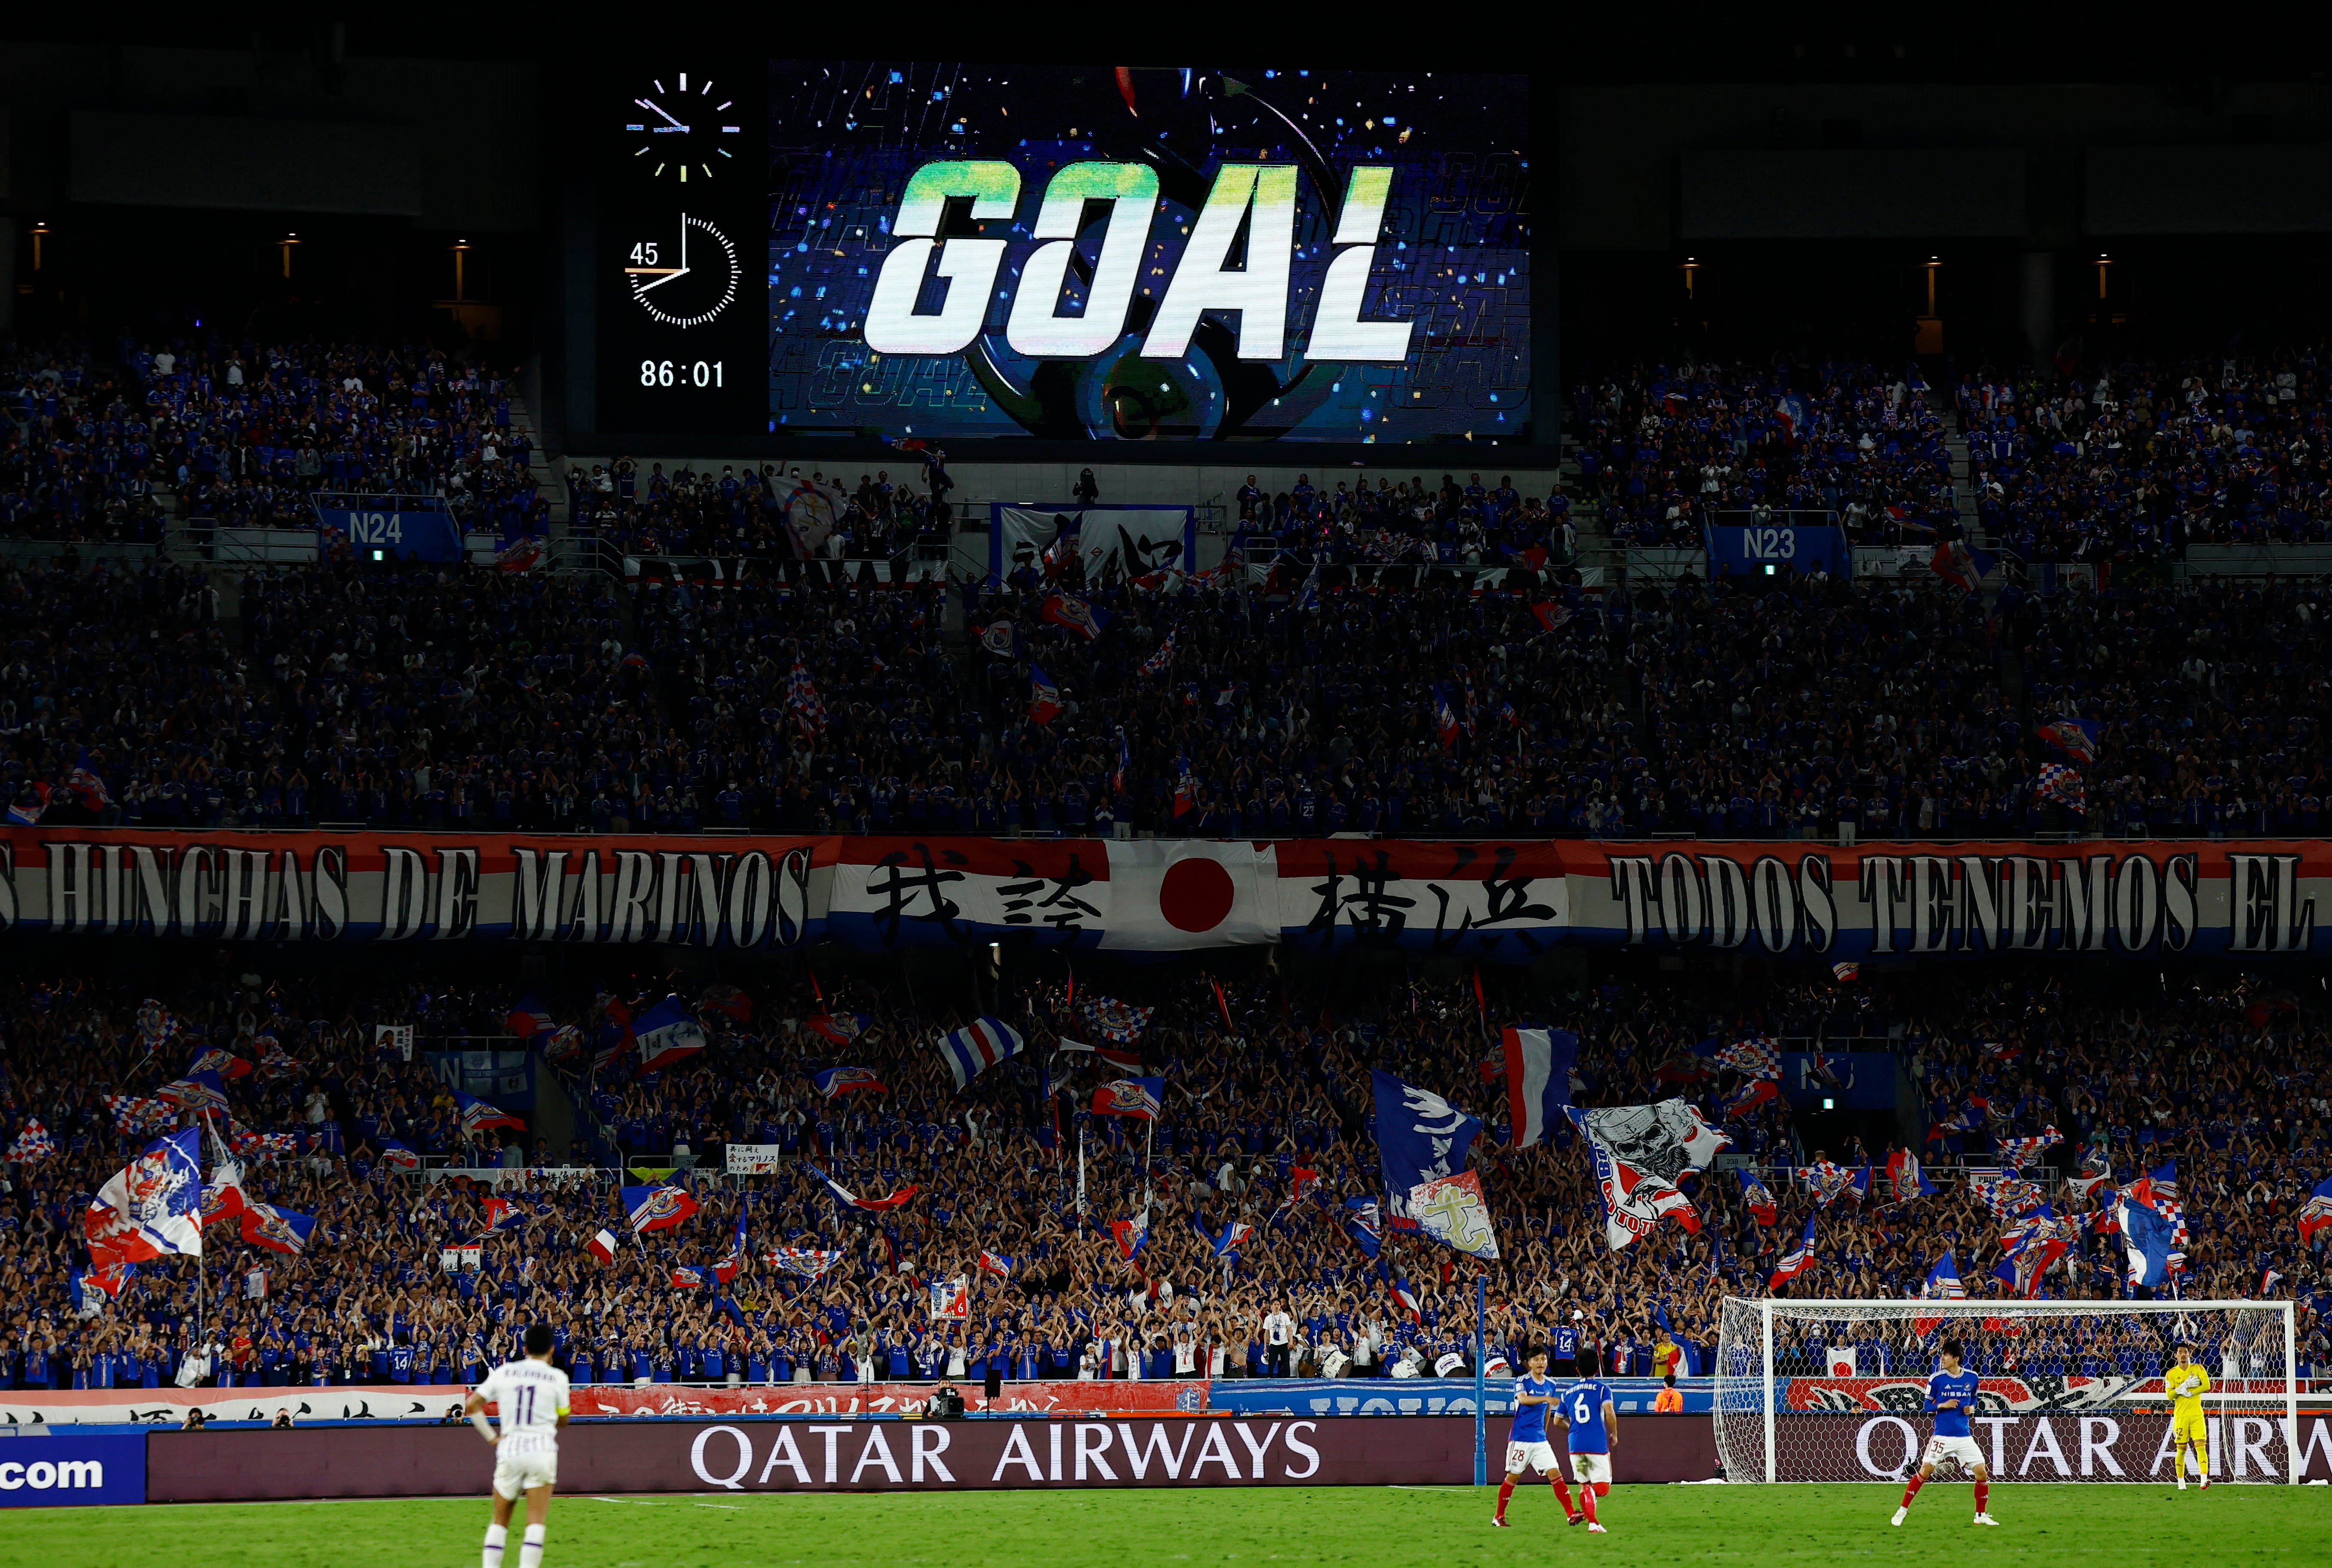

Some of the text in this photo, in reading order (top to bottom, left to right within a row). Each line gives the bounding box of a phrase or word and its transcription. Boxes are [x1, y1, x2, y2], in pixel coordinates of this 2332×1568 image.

[630, 242, 658, 265] 45
[864, 158, 1413, 361] GOAL
[641, 360, 723, 388] 86:01
[350, 512, 402, 544] N24
[1744, 528, 1795, 558] N23
[42, 841, 348, 941] HINCHAS
[375, 845, 480, 941] DE
[508, 846, 813, 948] MARINOS
[1305, 846, 1557, 955] 横浜
[1605, 852, 2314, 954] TODOS TENEMOS EL
[729, 1153, 776, 1163] 愛するマリノス
[1617, 1209, 1640, 1232] TO
[958, 1302, 964, 1313] 6
[1559, 1335, 1572, 1351] 14
[394, 1356, 408, 1370] 14
[1565, 1383, 1598, 1395] WATANABE
[515, 1386, 536, 1425] 11
[1574, 1392, 1591, 1424] 6
[691, 1421, 1320, 1489] QATAR AIRWAYS
[1512, 1449, 1525, 1462] 28
[1856, 1416, 2126, 1481] QTAR
[1931, 1441, 1945, 1454] 35
